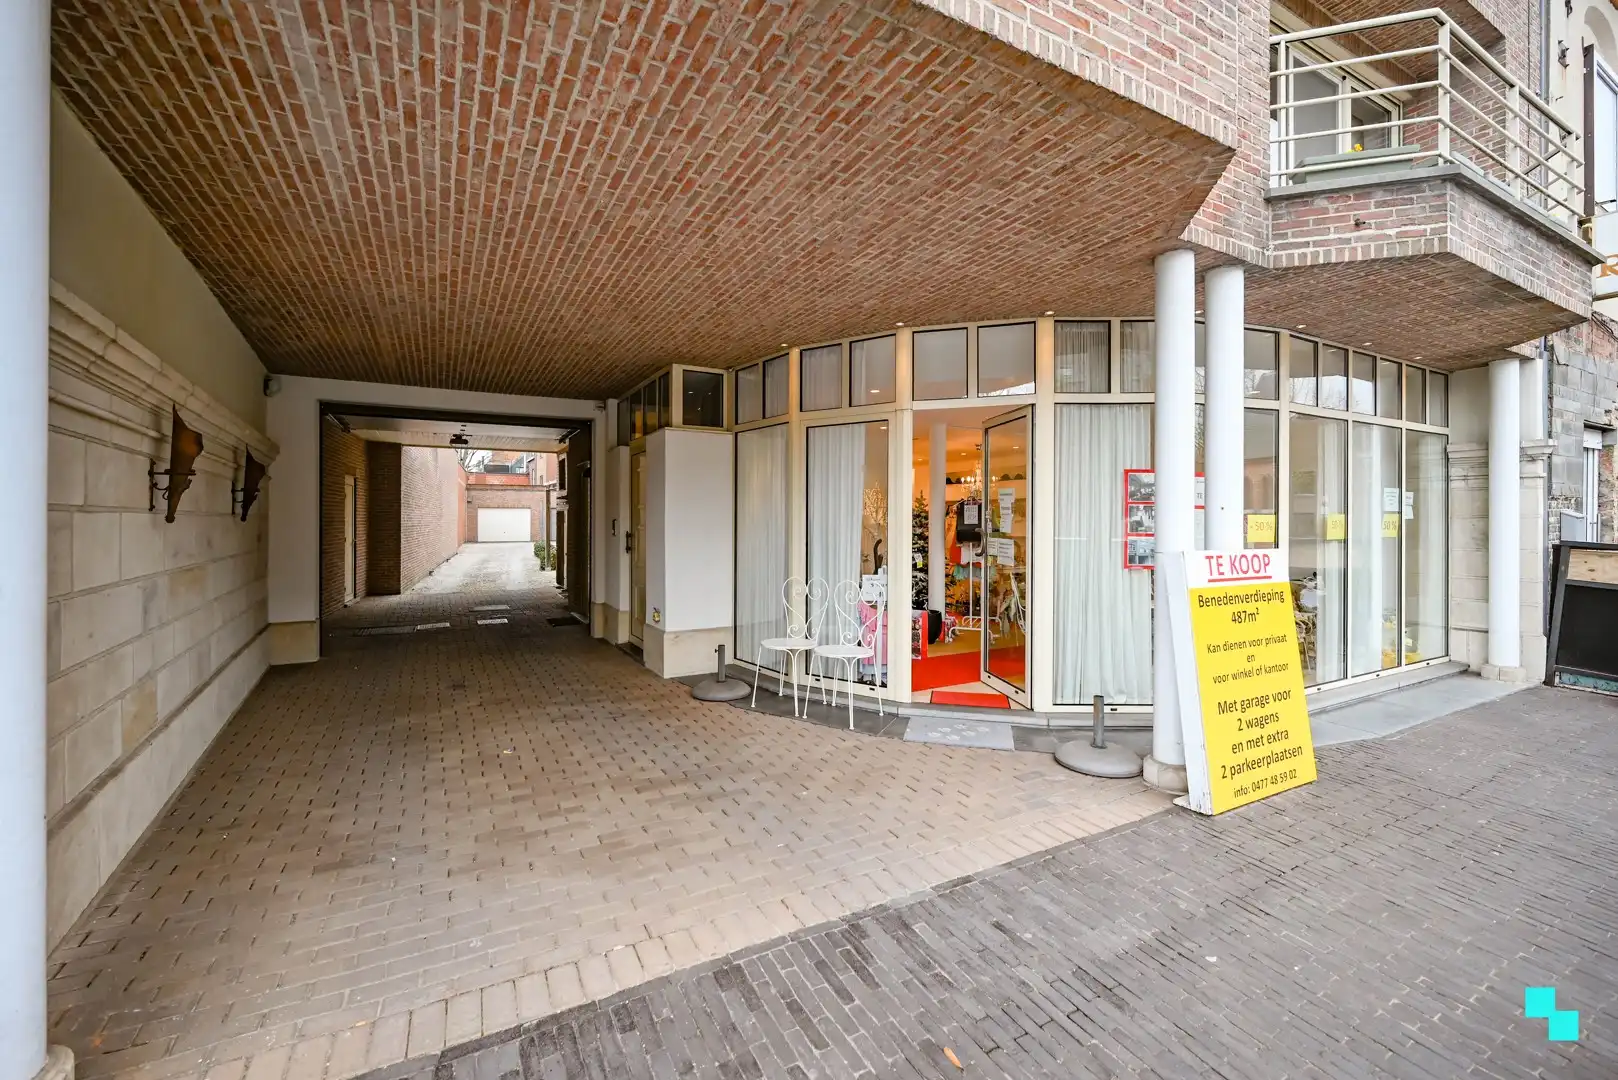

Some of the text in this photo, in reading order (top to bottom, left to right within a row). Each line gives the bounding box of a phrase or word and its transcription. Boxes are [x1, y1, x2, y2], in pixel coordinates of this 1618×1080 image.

[1205, 553, 1271, 576] TE KOOP
[1198, 588, 1285, 608] Benedenverdieping
[1231, 607, 1260, 624] 487m²
[1207, 634, 1287, 654] Kan dienen voor privaat
[1246, 653, 1256, 663] en
[1213, 662, 1289, 684] voor winkel of kantoor
[1218, 689, 1292, 715] Met garage voor
[1237, 712, 1280, 732] 2 wagens
[1231, 729, 1289, 754] en met extra
[1221, 745, 1303, 780] 2 parkeerplaatsen
[1233, 768, 1298, 798] info: 0477 48 59 02
